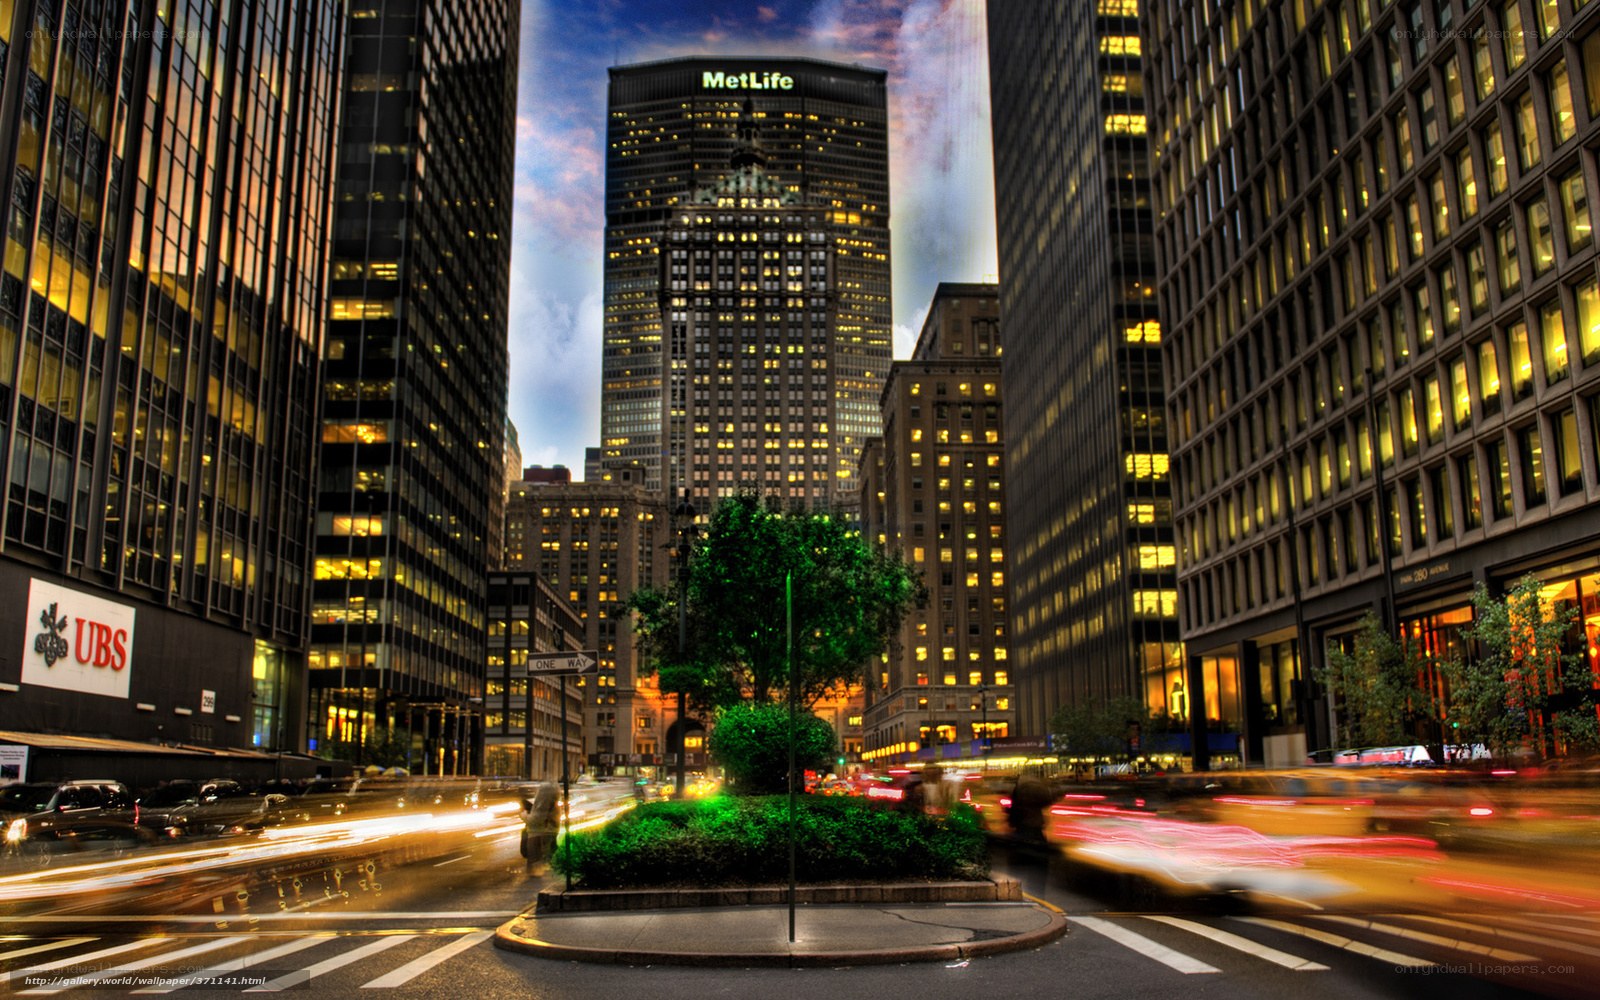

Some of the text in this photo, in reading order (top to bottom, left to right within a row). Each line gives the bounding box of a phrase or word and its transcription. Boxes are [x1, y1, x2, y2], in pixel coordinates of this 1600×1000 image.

[703, 71, 794, 90] MetLife
[1414, 568, 1428, 584] 280
[75, 617, 128, 672] UBS
[536, 658, 588, 670] ONE WAY
